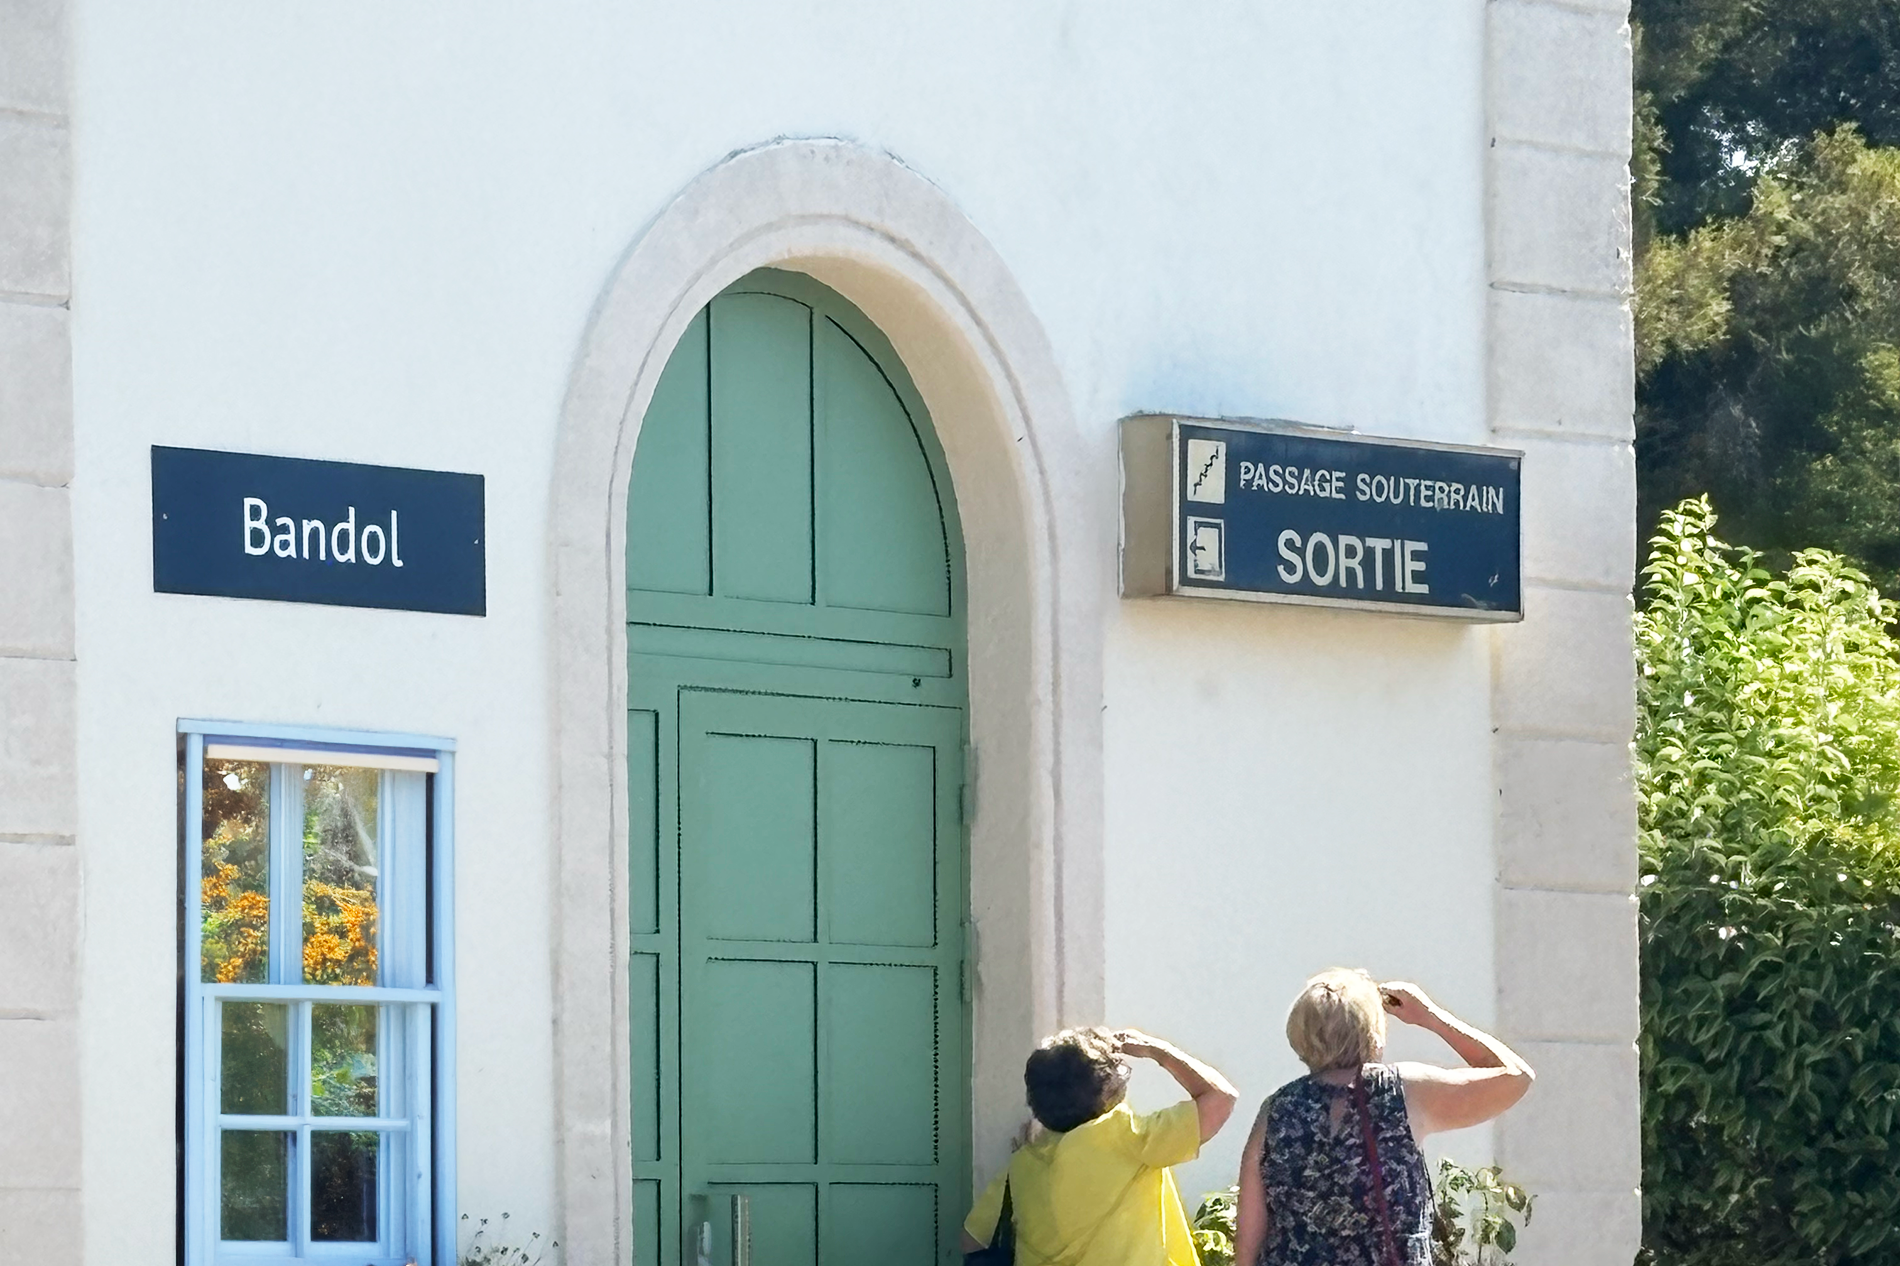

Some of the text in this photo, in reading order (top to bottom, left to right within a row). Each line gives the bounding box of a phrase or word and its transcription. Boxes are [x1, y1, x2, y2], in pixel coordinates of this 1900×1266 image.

[1239, 461, 1504, 514] PASSAGE SOUTERRAIN
[243, 497, 403, 567] Bandol
[1277, 529, 1429, 594] SORTIE
